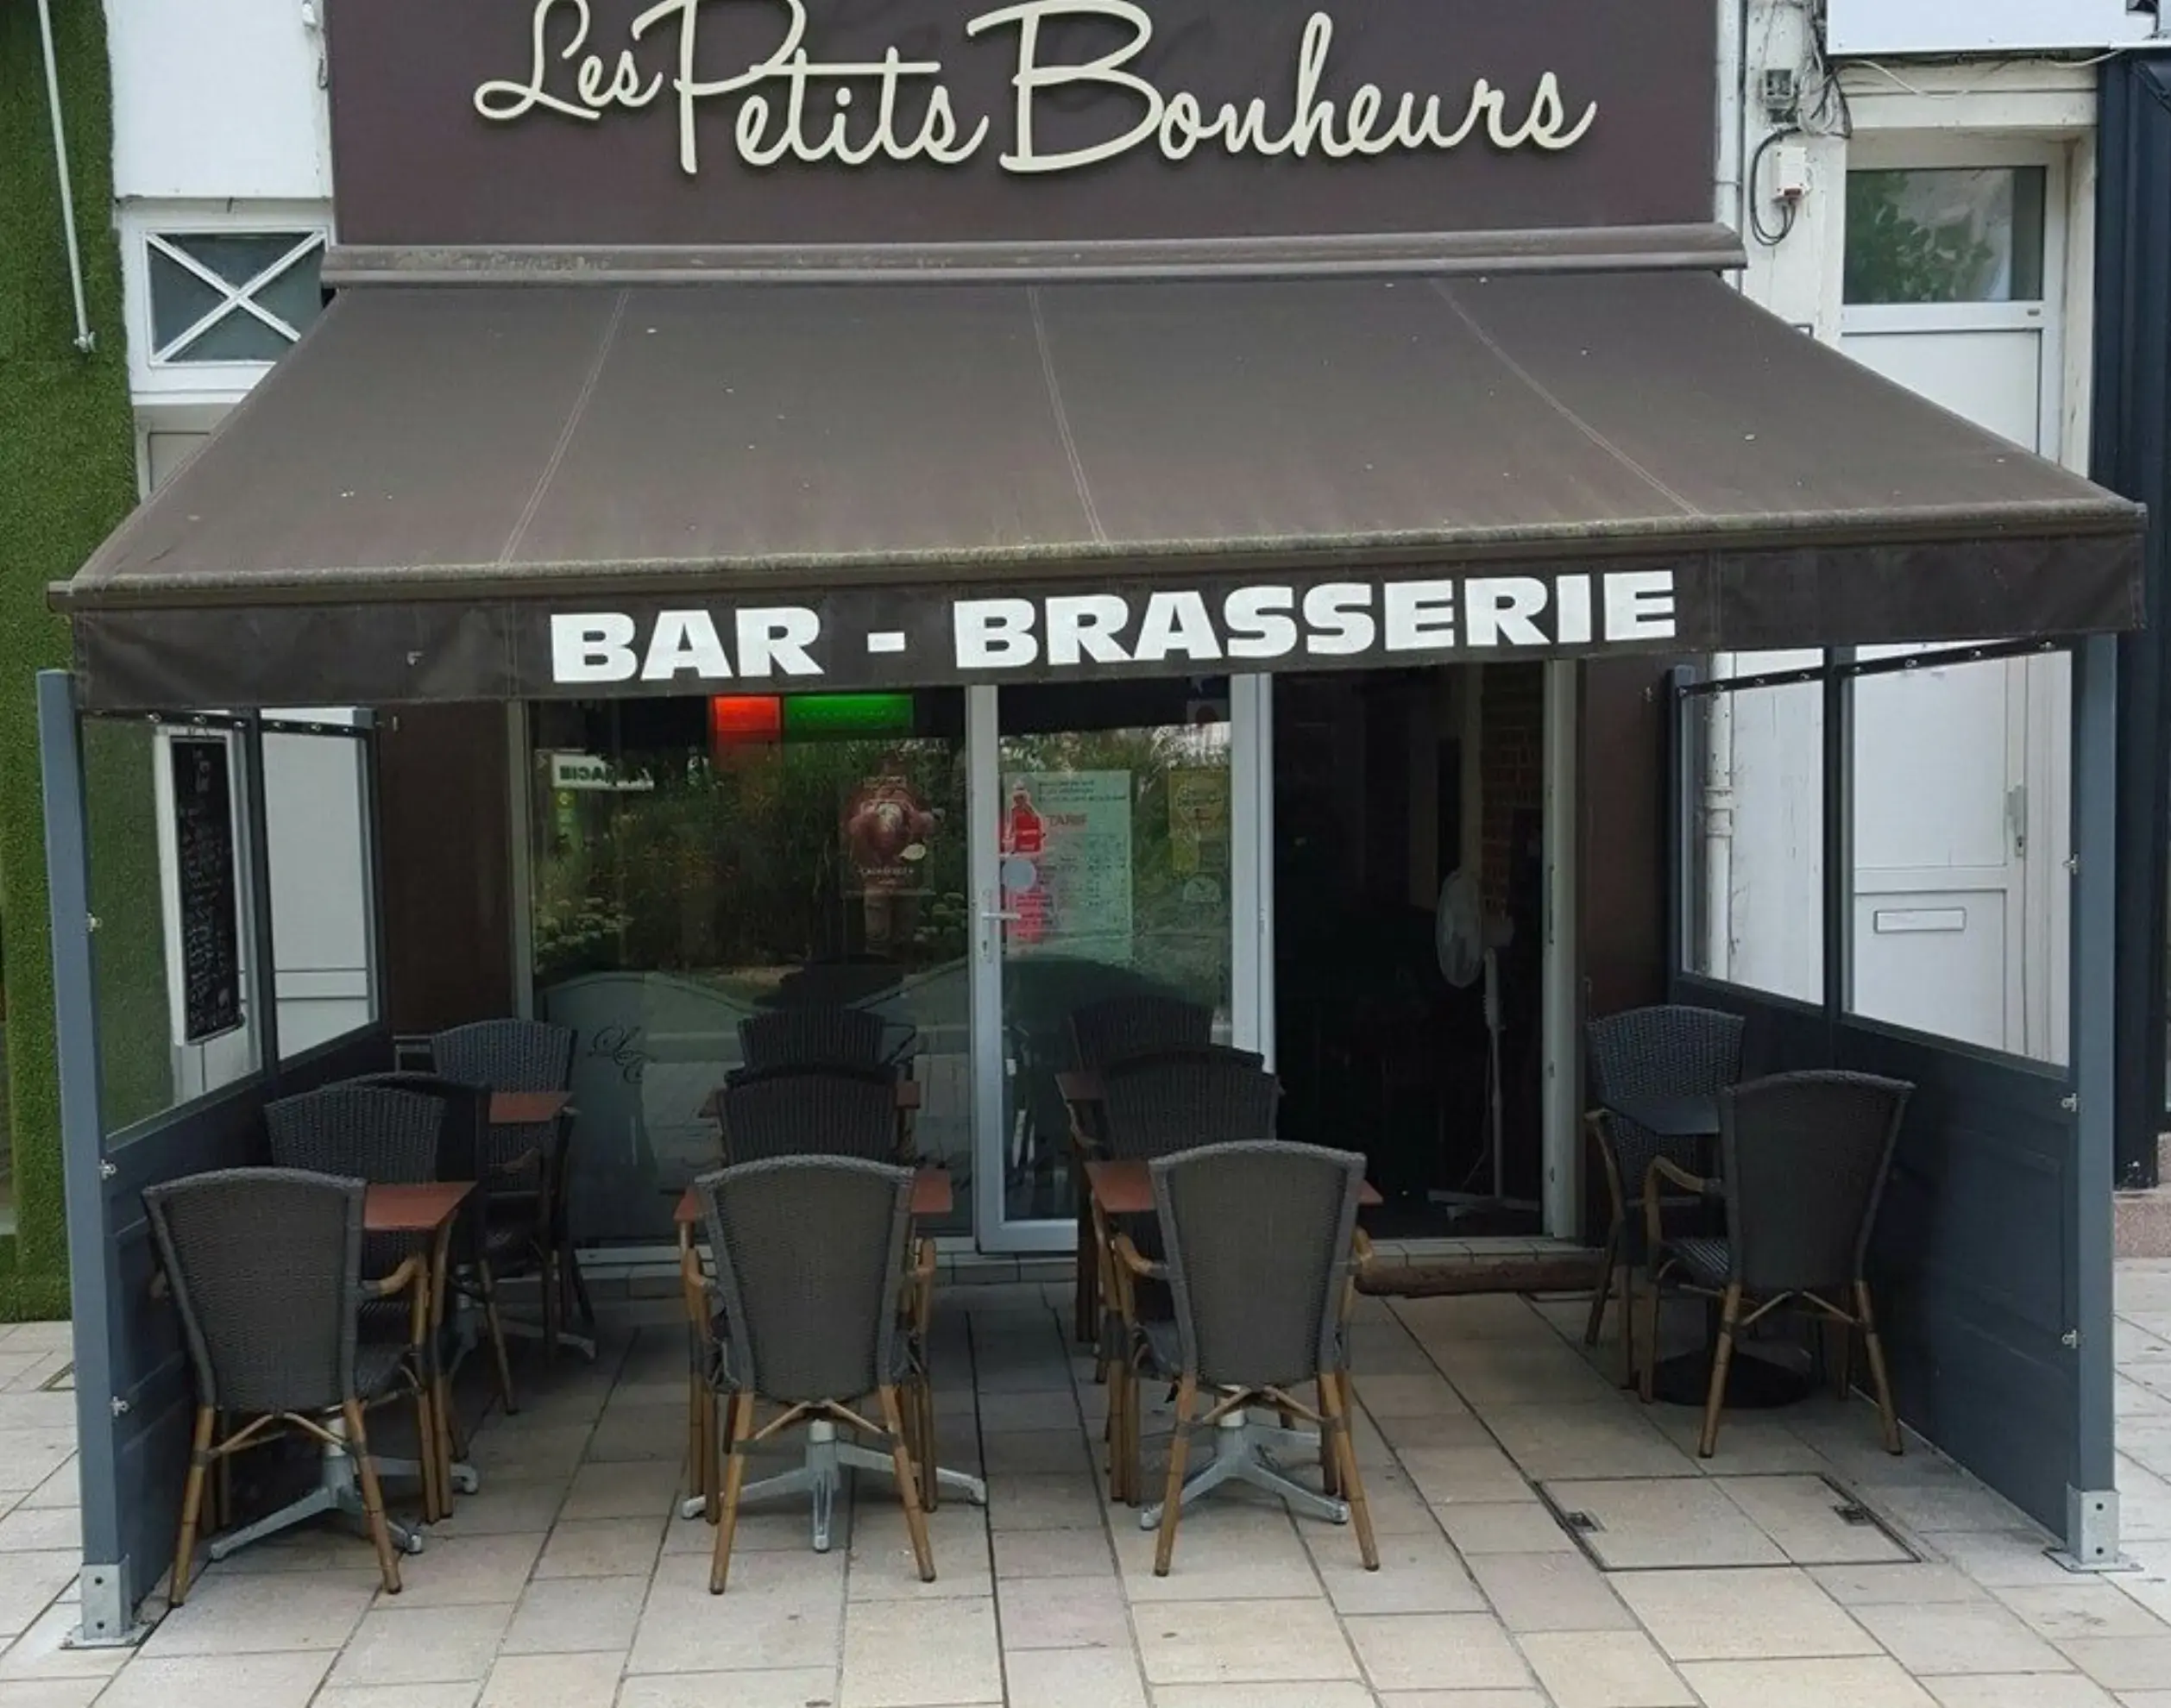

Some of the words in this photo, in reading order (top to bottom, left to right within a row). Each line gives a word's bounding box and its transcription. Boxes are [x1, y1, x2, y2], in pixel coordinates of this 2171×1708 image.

[473, 0, 664, 120] Les
[631, 0, 991, 174] Petits
[966, 0, 1598, 173] Bonheurs
[550, 606, 825, 683] BAR
[866, 631, 906, 653] -
[953, 569, 1677, 669] BRASSERIE
